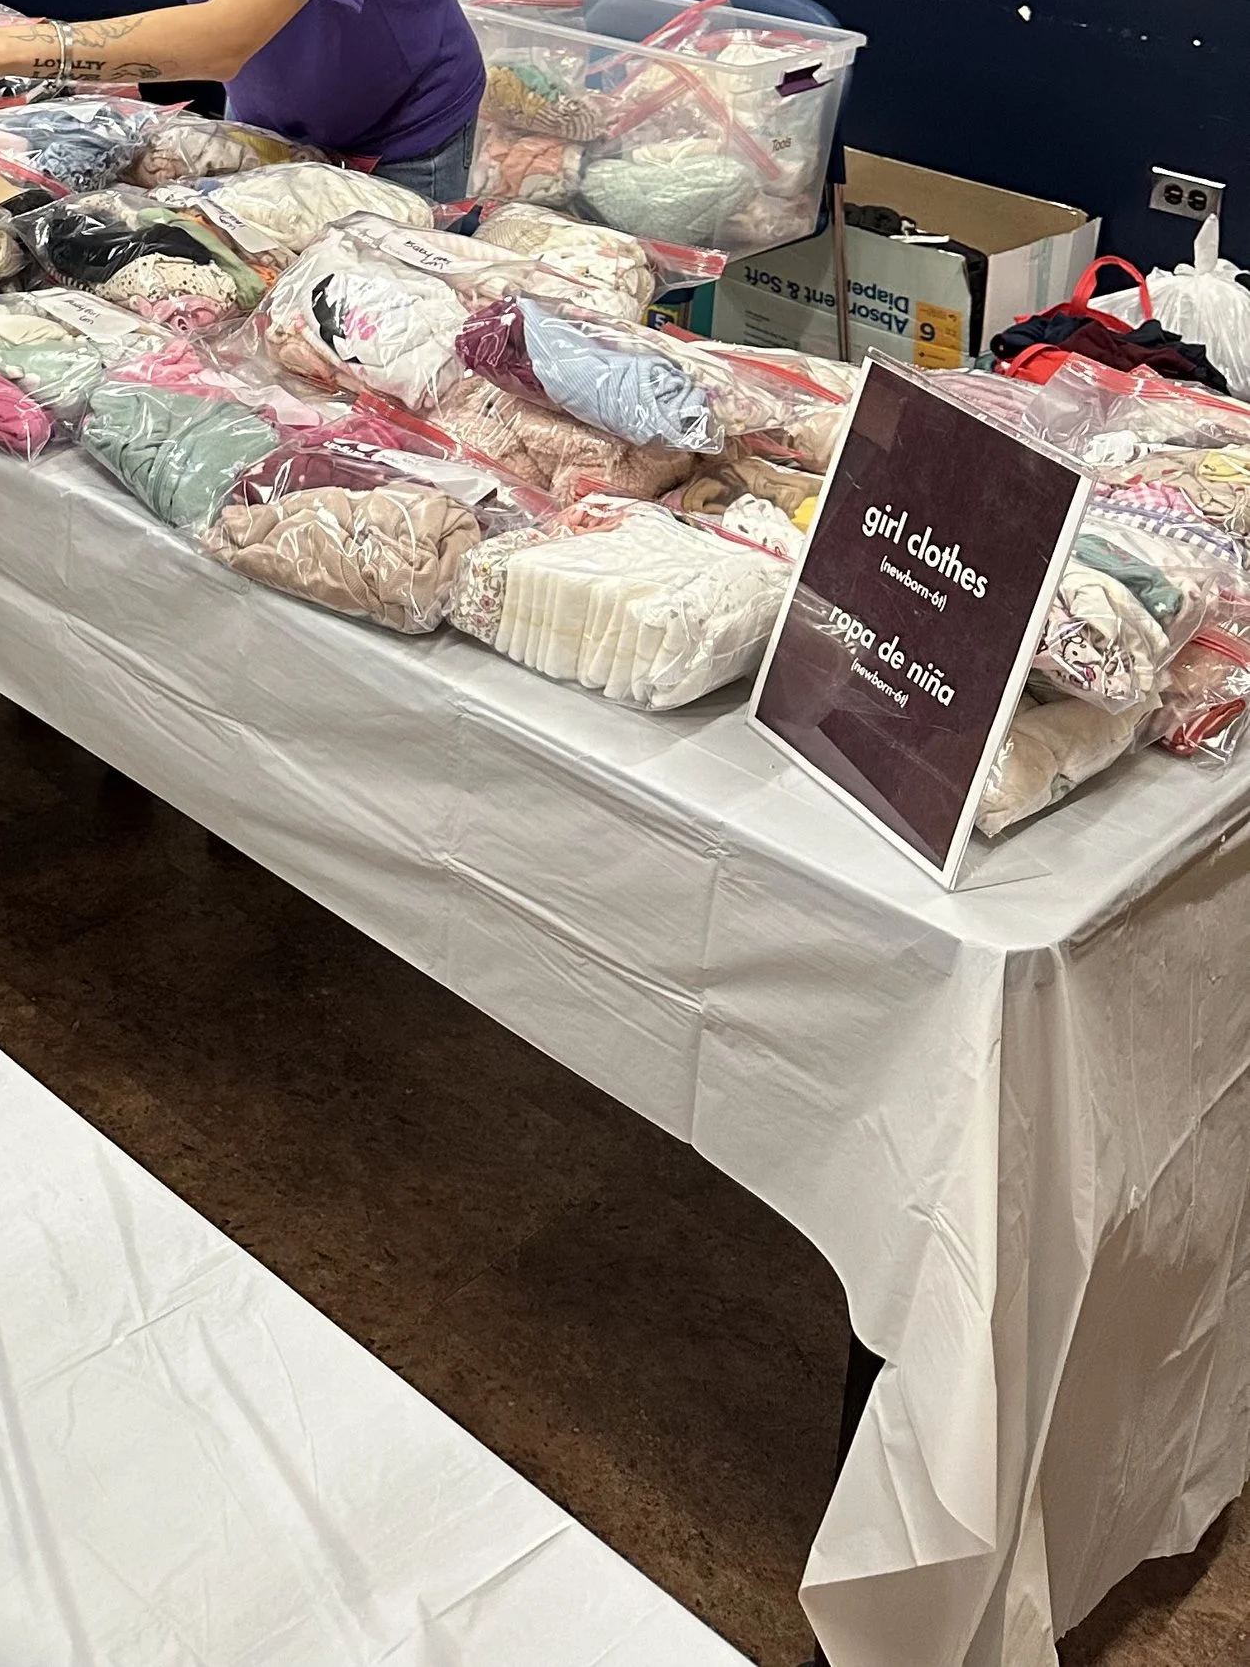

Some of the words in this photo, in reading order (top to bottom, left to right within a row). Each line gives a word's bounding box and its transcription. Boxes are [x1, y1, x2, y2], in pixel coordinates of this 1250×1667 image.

[744, 265, 783, 294] Soft
[804, 285, 909, 335] Absorent
[862, 504, 908, 545] girl
[907, 526, 989, 599] clothes
[879, 555, 948, 613] (newborn-6t)
[828, 605, 877, 650] ropa
[877, 635, 905, 670] de
[906, 662, 956, 707] niña
[851, 657, 909, 709] (newborn-6t)
